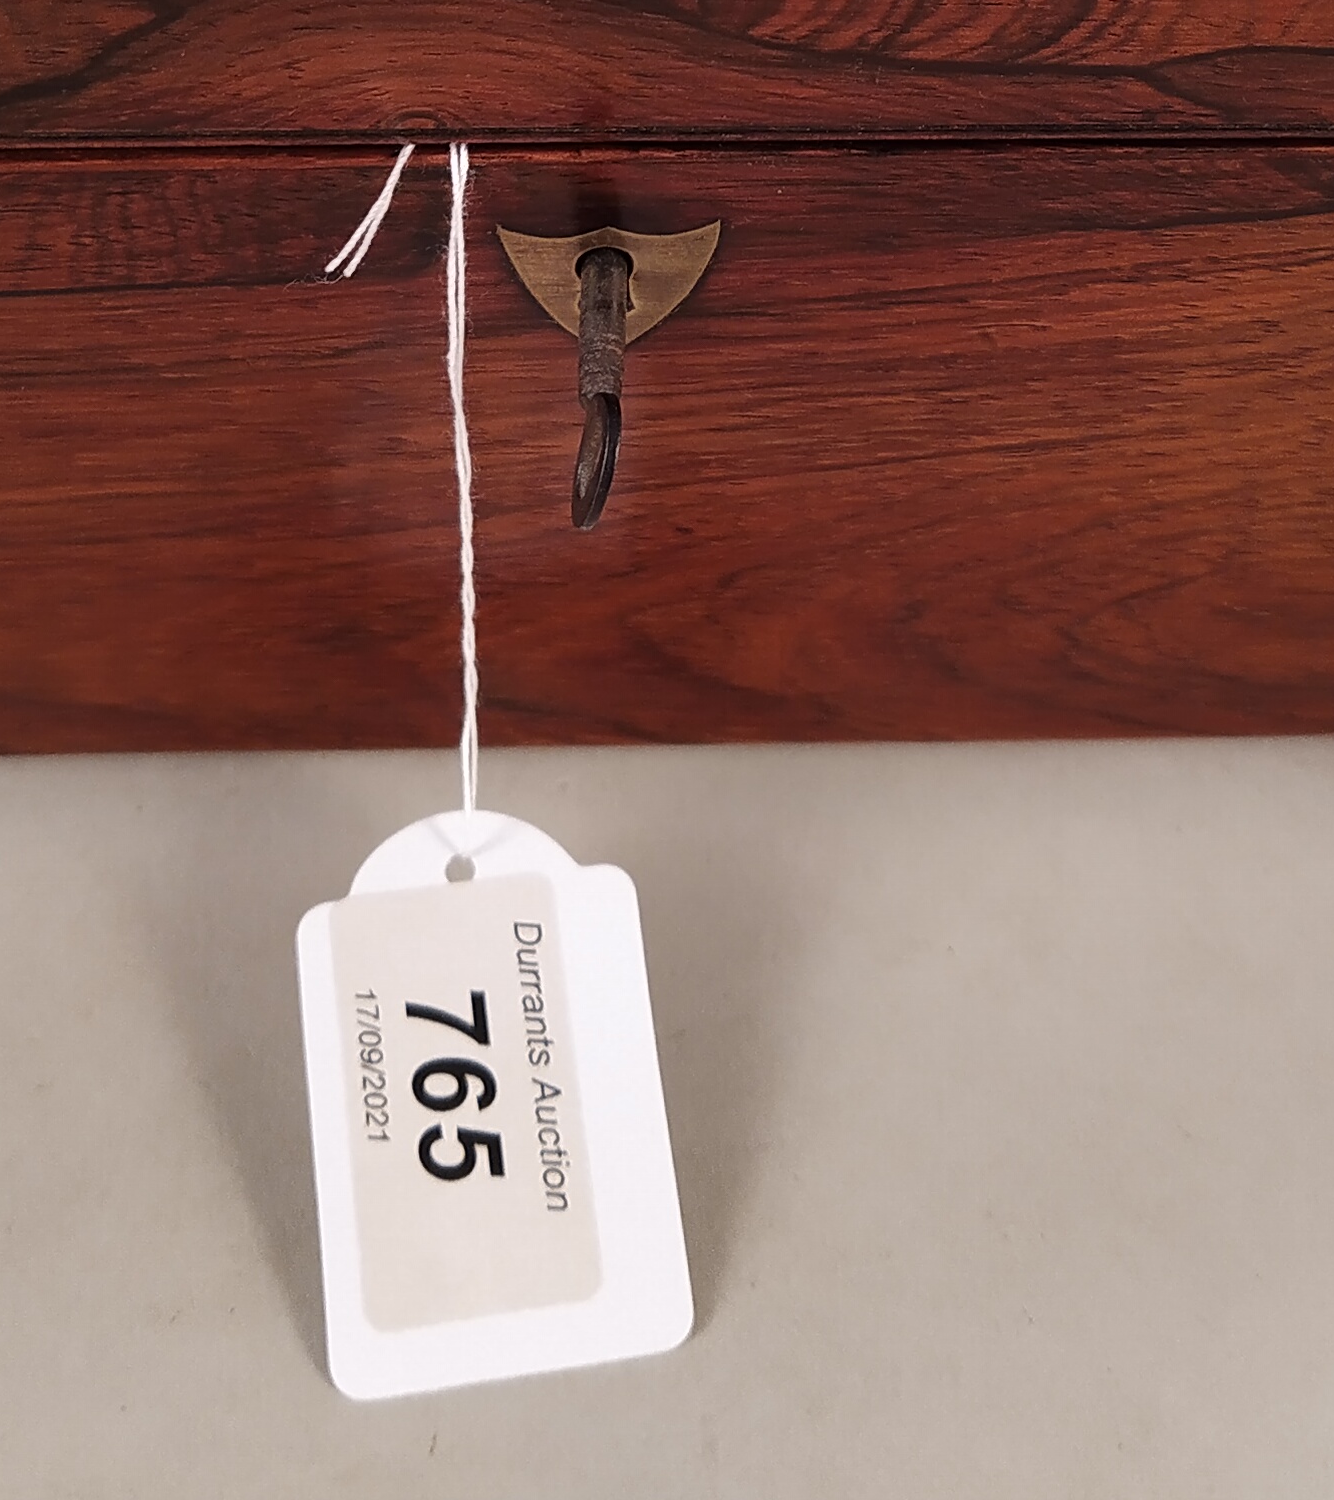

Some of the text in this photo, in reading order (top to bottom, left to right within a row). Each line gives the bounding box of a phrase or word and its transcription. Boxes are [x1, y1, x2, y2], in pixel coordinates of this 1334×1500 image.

[354, 988, 391, 1144] 17/09/2021
[405, 989, 505, 1182] 765
[513, 921, 570, 1212] Durrants Auction
